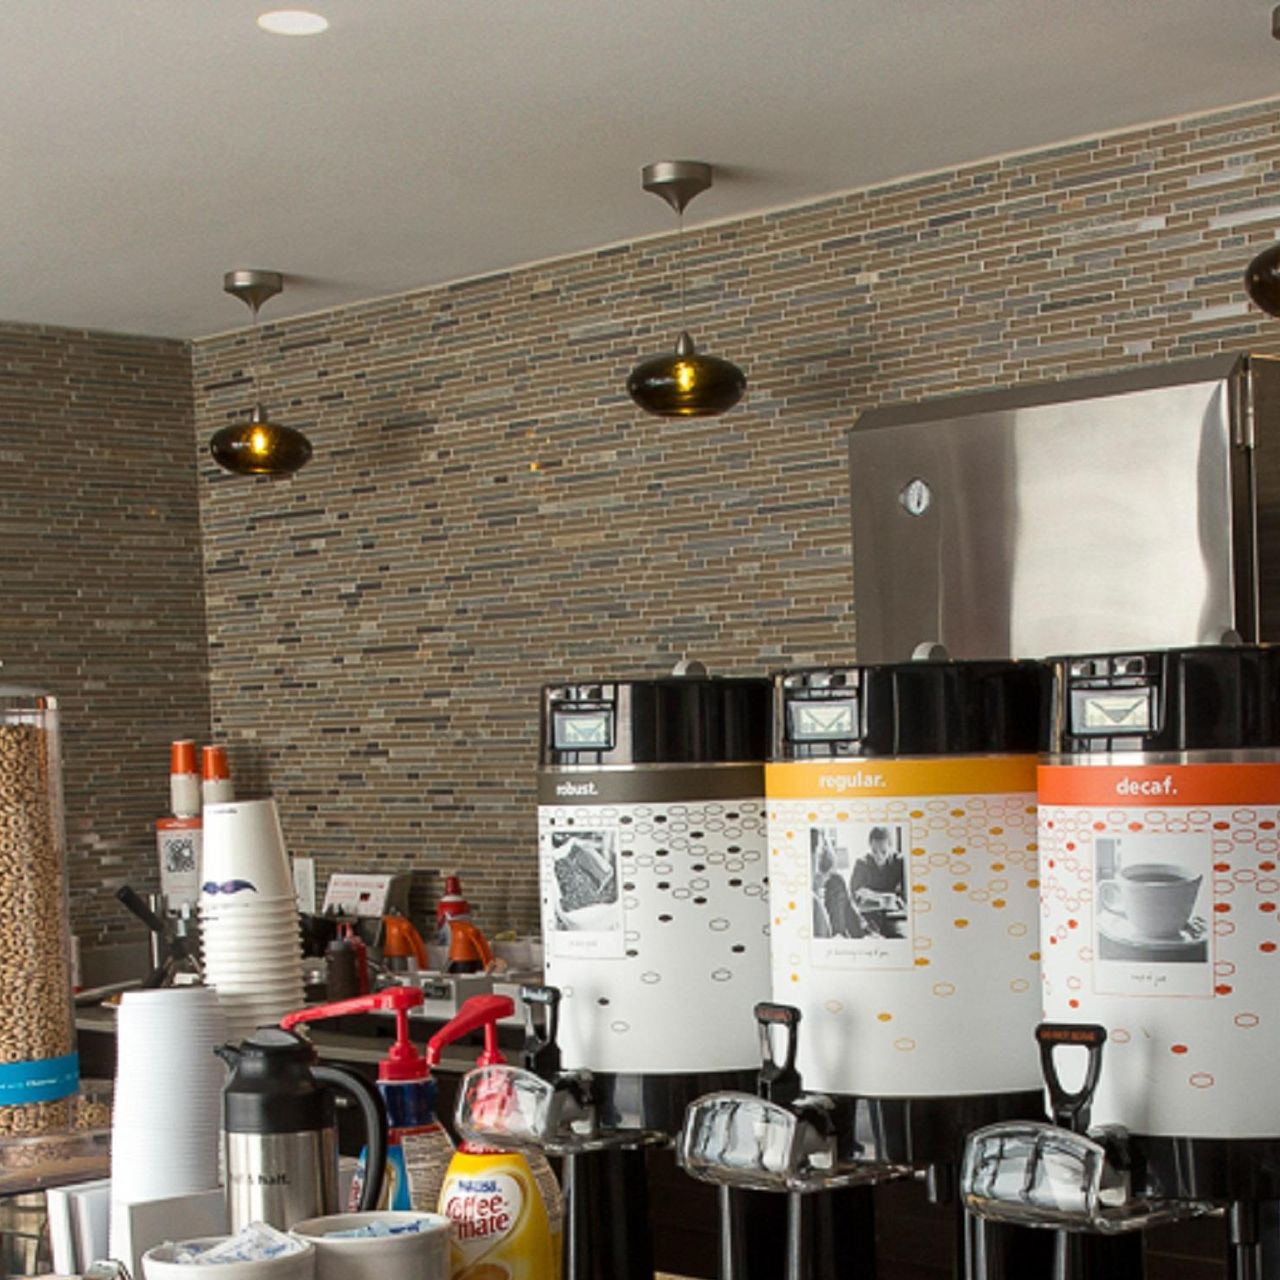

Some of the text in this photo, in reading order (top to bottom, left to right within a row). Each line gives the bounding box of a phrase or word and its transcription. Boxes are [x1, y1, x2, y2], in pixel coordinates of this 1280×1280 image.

[555, 780, 599, 797] robust.
[820, 771, 888, 792] regular.
[1115, 775, 1179, 796] decaf.
[458, 1212, 510, 1240] mate
